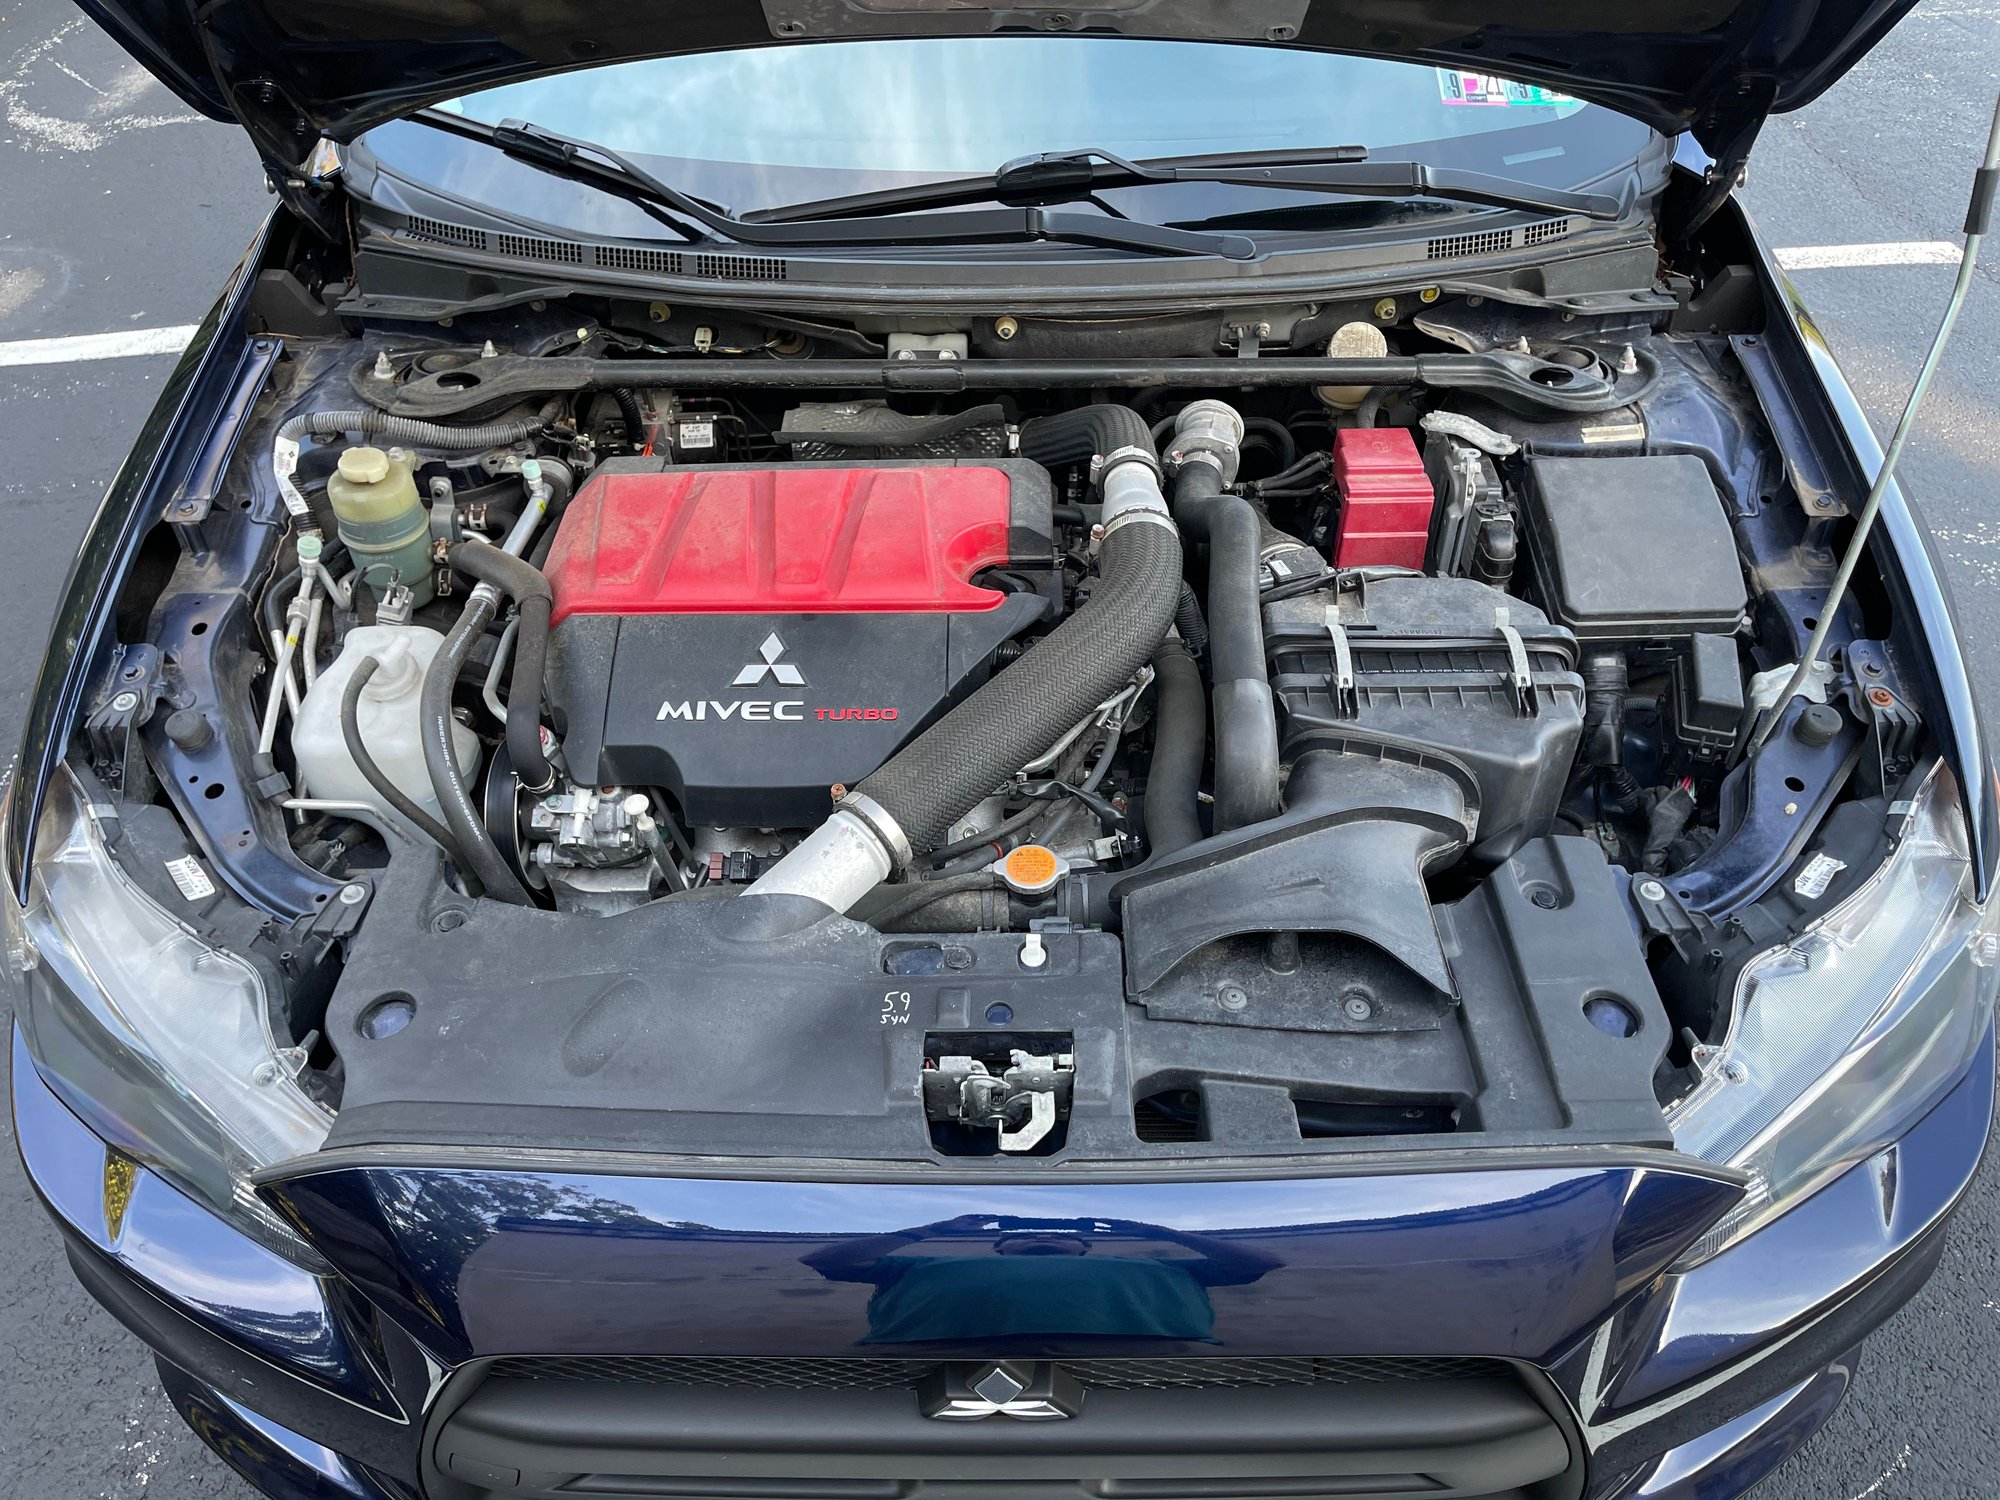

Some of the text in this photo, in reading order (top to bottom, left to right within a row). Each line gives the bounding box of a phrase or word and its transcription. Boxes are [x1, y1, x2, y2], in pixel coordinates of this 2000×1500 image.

[1449, 73, 1461, 98] 9
[655, 700, 898, 721] MIVEC TURBO
